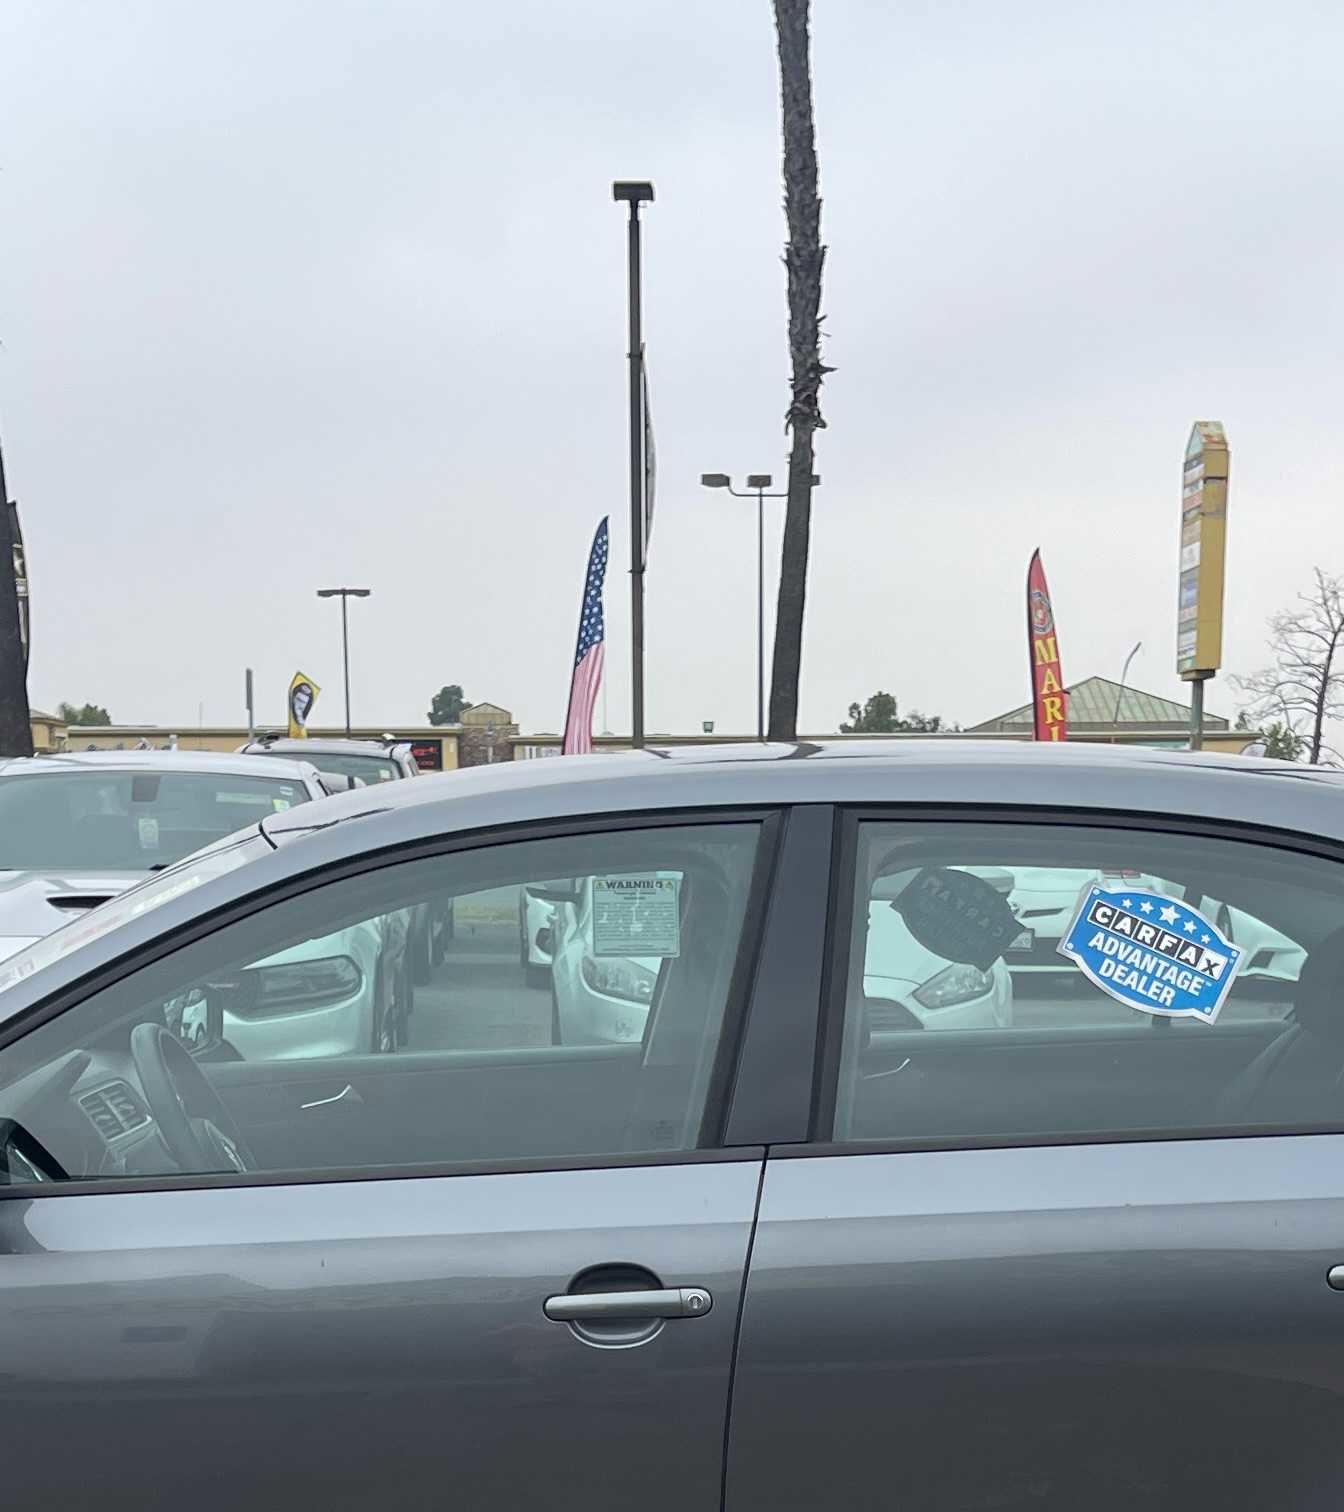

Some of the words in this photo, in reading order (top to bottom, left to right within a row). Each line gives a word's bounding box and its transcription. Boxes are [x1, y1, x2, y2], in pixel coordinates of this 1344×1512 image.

[606, 881, 662, 889] WARNING
[1088, 931, 1205, 996] ADVANTAGE
[1094, 904, 1222, 979] CARFAX
[1098, 959, 1177, 1007] DEALER
